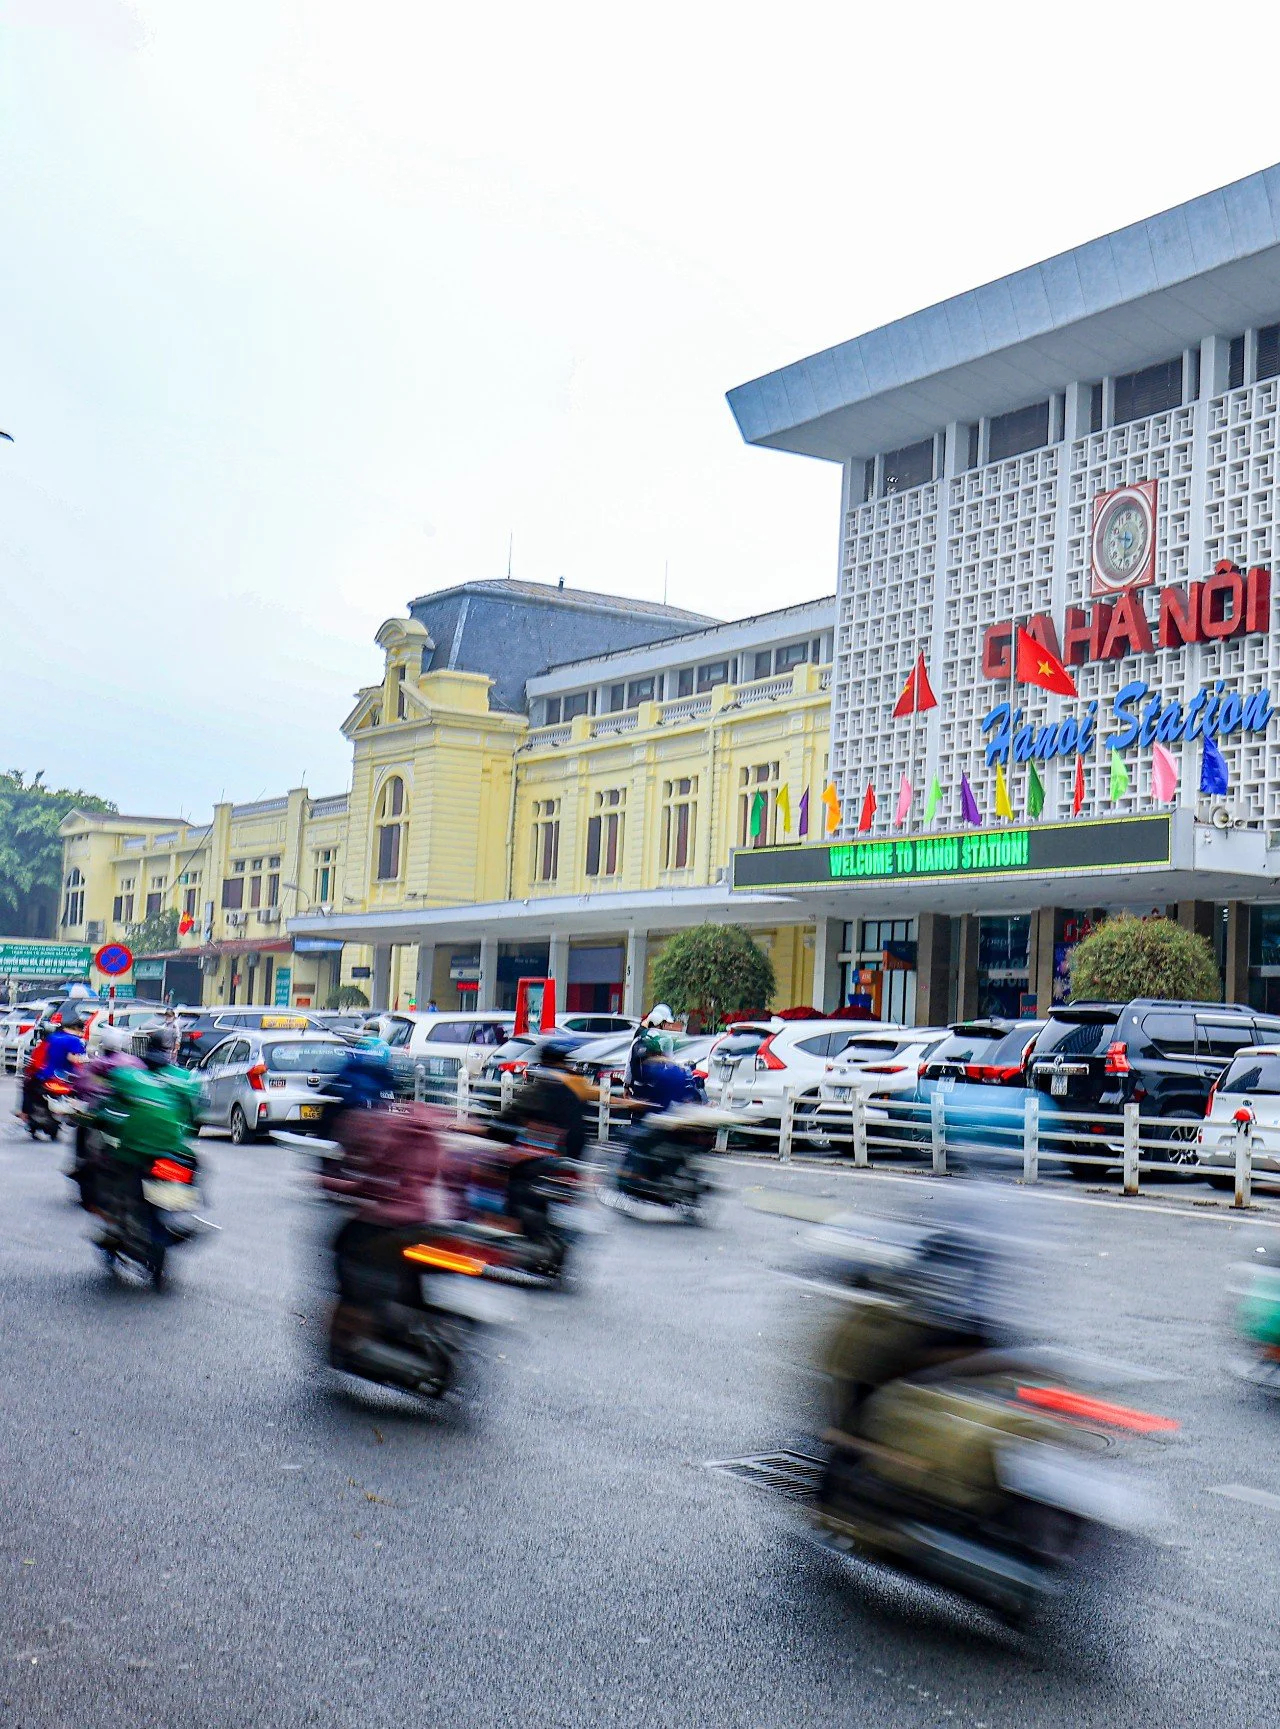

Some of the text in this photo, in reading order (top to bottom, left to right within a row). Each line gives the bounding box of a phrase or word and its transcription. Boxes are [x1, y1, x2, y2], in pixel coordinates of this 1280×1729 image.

[1158, 559, 1270, 649] NỘI
[982, 680, 1275, 767] Hanoi Station
[830, 832, 1029, 877] WELCOME TO HANOI STATION!
